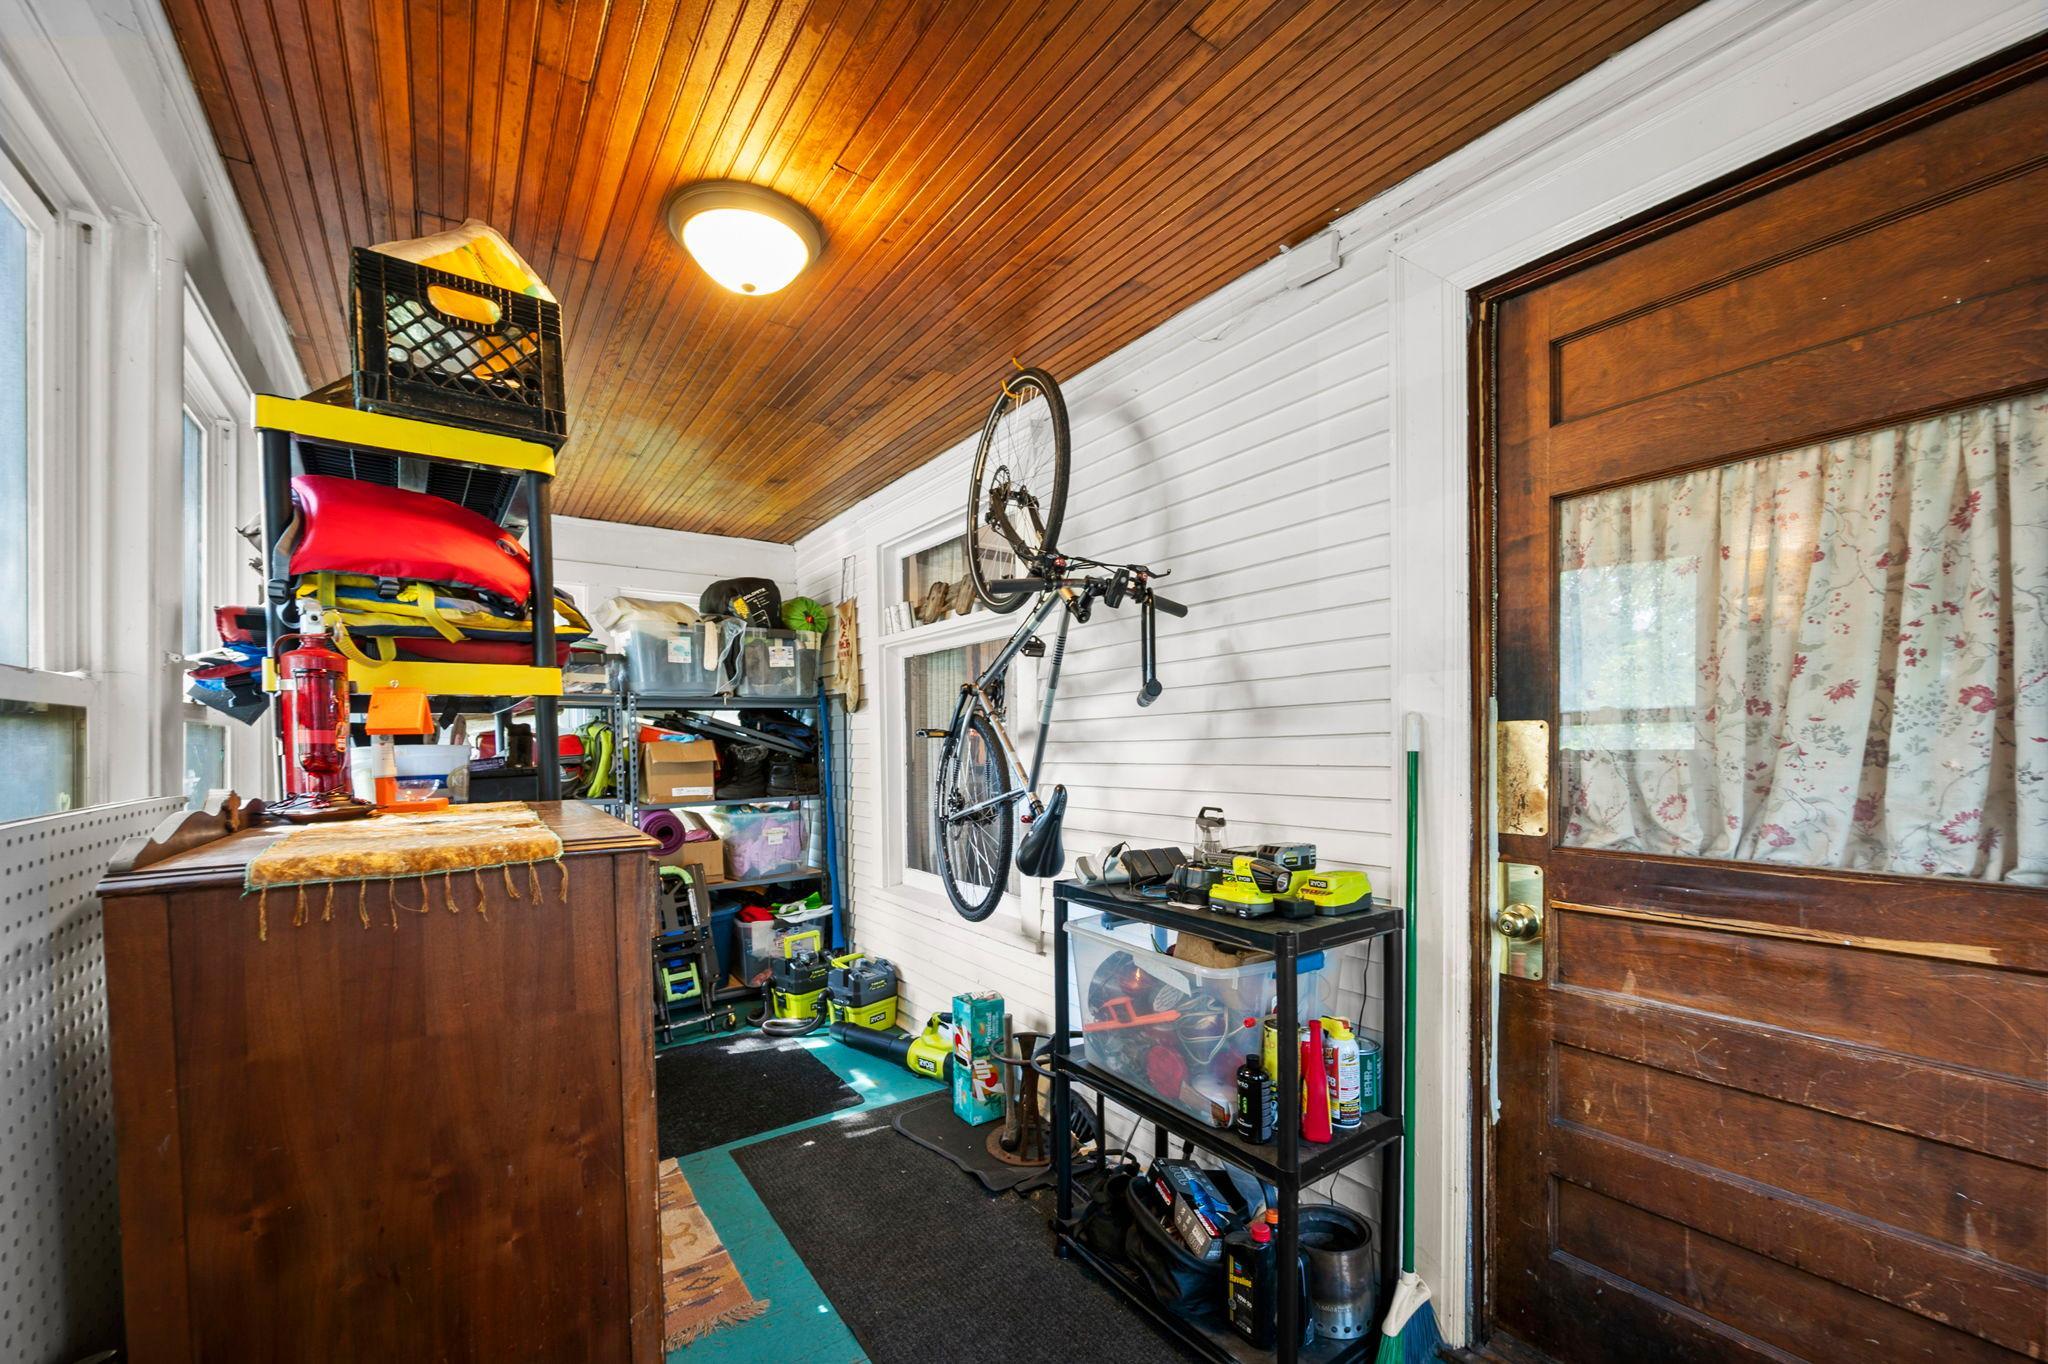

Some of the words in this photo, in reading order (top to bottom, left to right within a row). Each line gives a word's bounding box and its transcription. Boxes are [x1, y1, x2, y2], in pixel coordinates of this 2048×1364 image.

[1310, 880, 1328, 888] RYOBI
[871, 1013, 885, 1023] RYOBI
[919, 1058, 935, 1071] RYOBI
[1363, 1071, 1373, 1097] BEHR
